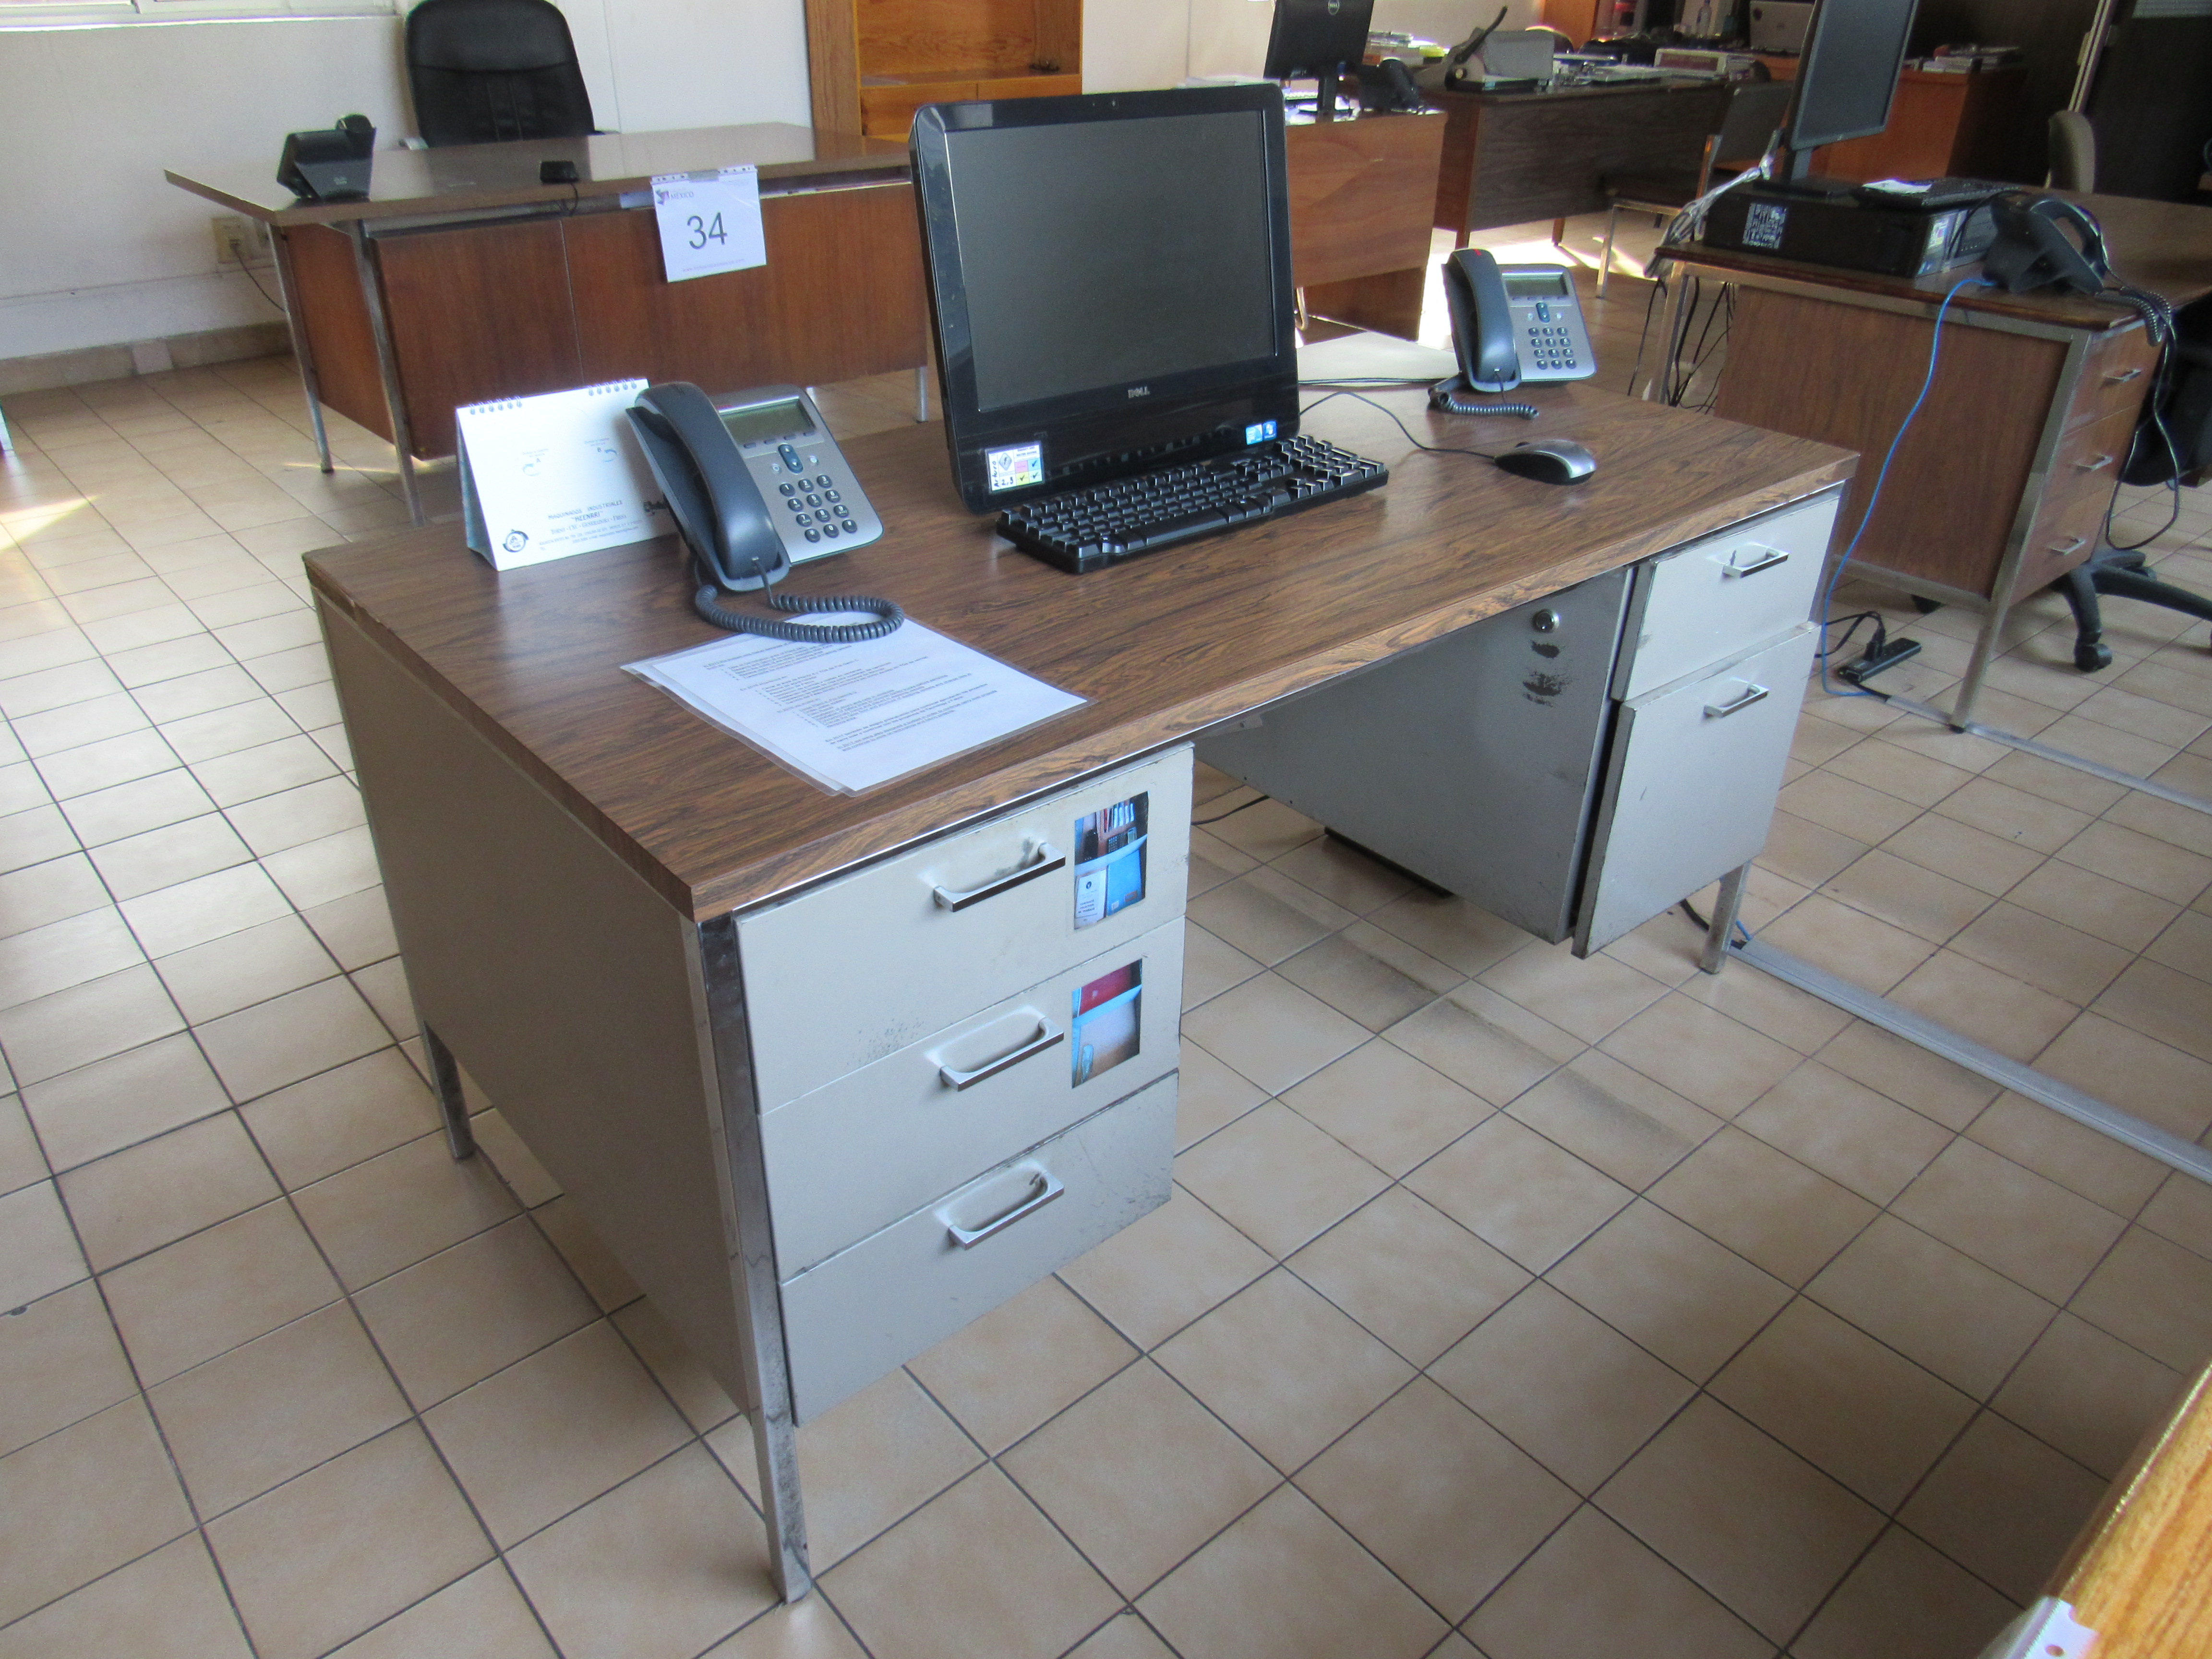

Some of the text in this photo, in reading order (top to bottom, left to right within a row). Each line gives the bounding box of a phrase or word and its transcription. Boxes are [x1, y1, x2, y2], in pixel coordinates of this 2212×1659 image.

[686, 212, 728, 250] 34
[1128, 386, 1150, 398] DELL
[588, 500, 623, 512] INDUSTRIALES
